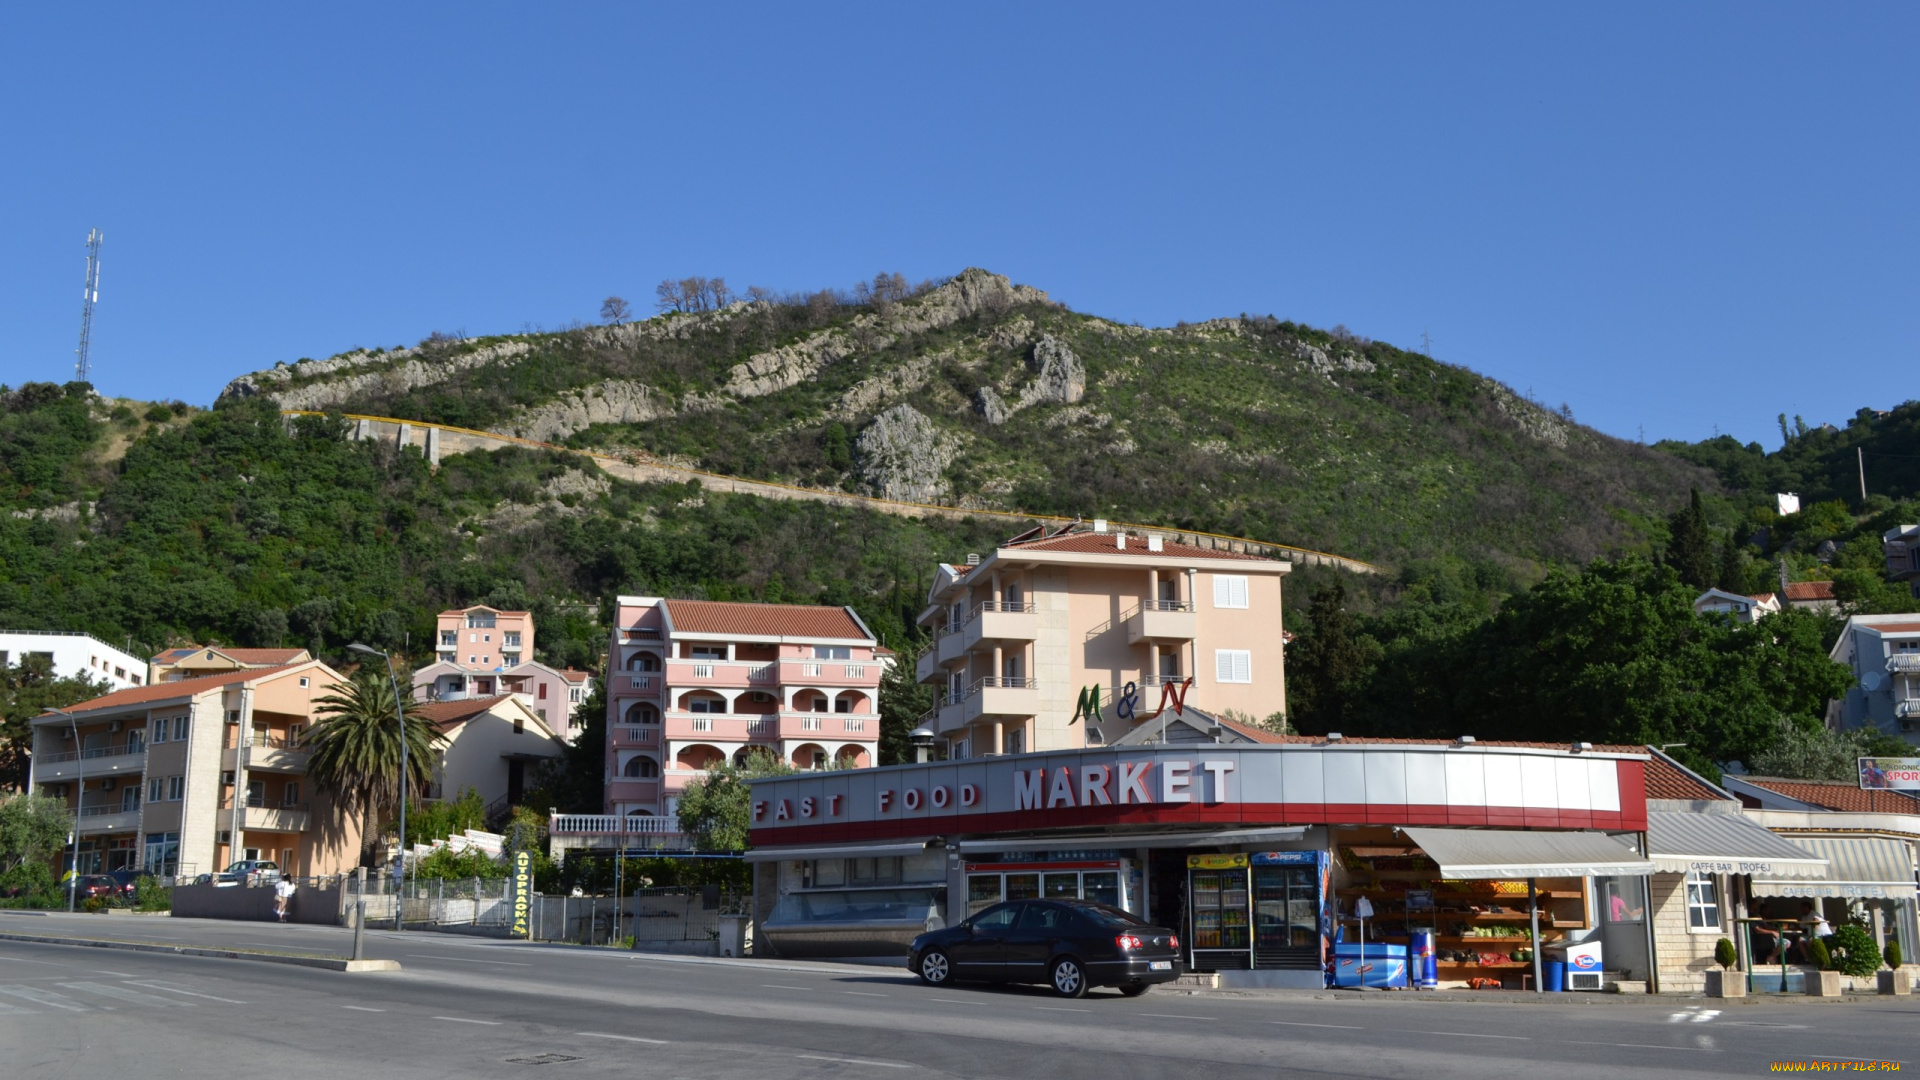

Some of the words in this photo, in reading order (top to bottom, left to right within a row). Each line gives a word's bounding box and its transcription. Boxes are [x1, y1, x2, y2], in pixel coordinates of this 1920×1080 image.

[1068, 683, 1103, 726] M
[1116, 681, 1139, 720] &
[1151, 677, 1193, 719] N
[1887, 771, 1920, 781] SPOR
[752, 794, 843, 822] FAST
[878, 784, 980, 813] FOOD
[1014, 761, 1234, 810] MARKET
[1690, 862, 1714, 871] CAFFE
[1716, 863, 1732, 871] BAR
[1738, 862, 1771, 872] TROFEJ
[515, 852, 529, 925] AUTOPRAONA
[1783, 887, 1814, 895] CAFFE
[1840, 886, 1885, 897] TROFEJ
